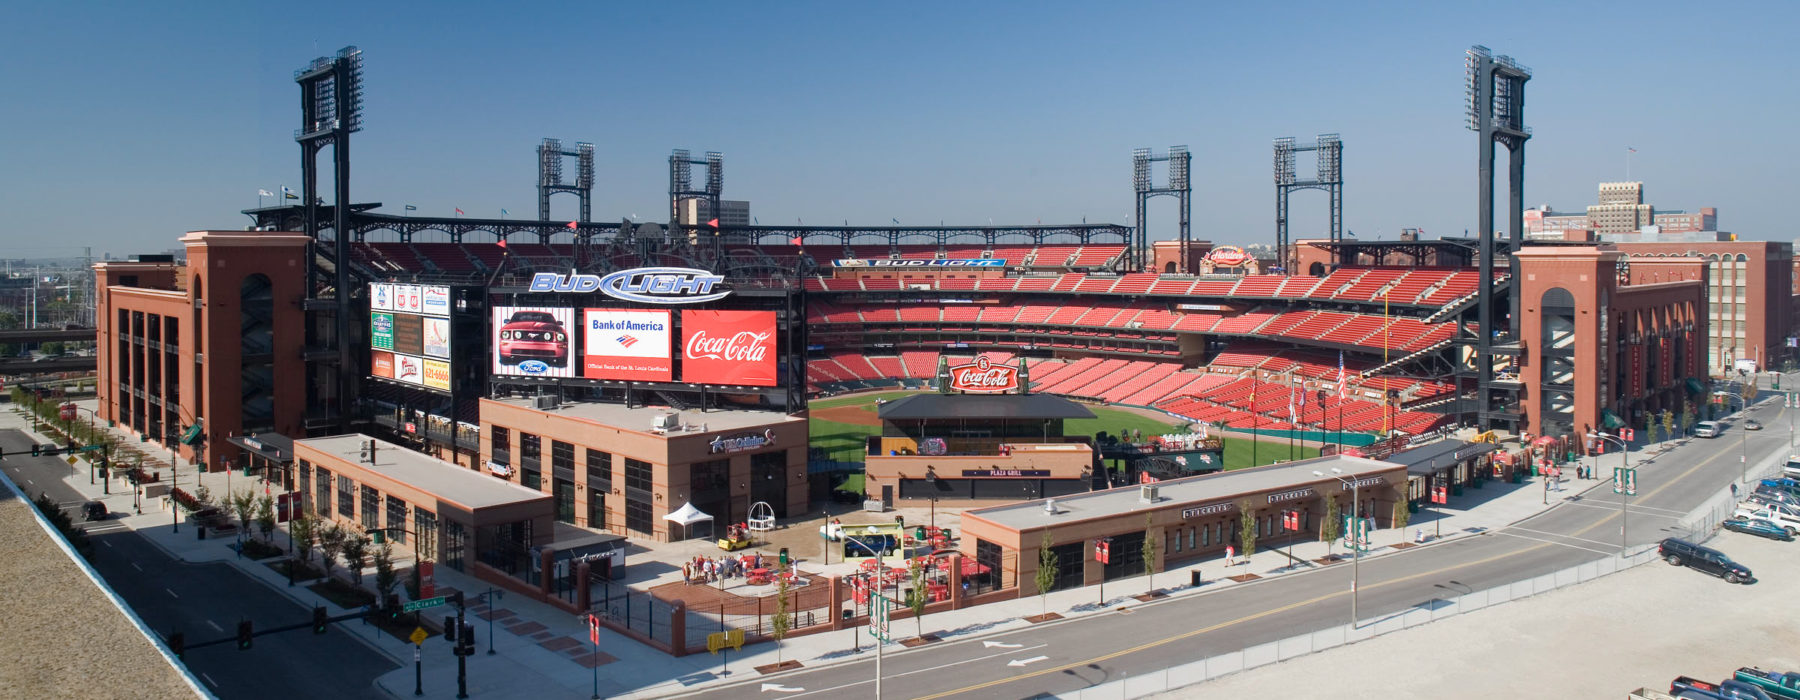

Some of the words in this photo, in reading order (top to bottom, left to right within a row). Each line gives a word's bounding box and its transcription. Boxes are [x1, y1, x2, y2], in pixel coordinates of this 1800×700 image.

[528, 272, 602, 293] BUD
[619, 274, 725, 294] LIGHT
[592, 319, 615, 331] Bank
[615, 319, 625, 331] of
[626, 320, 664, 332] America
[686, 329, 773, 362] Coca-Cola
[958, 368, 1010, 387] Coca-Cola
[1190, 503, 1227, 517] TICKETS
